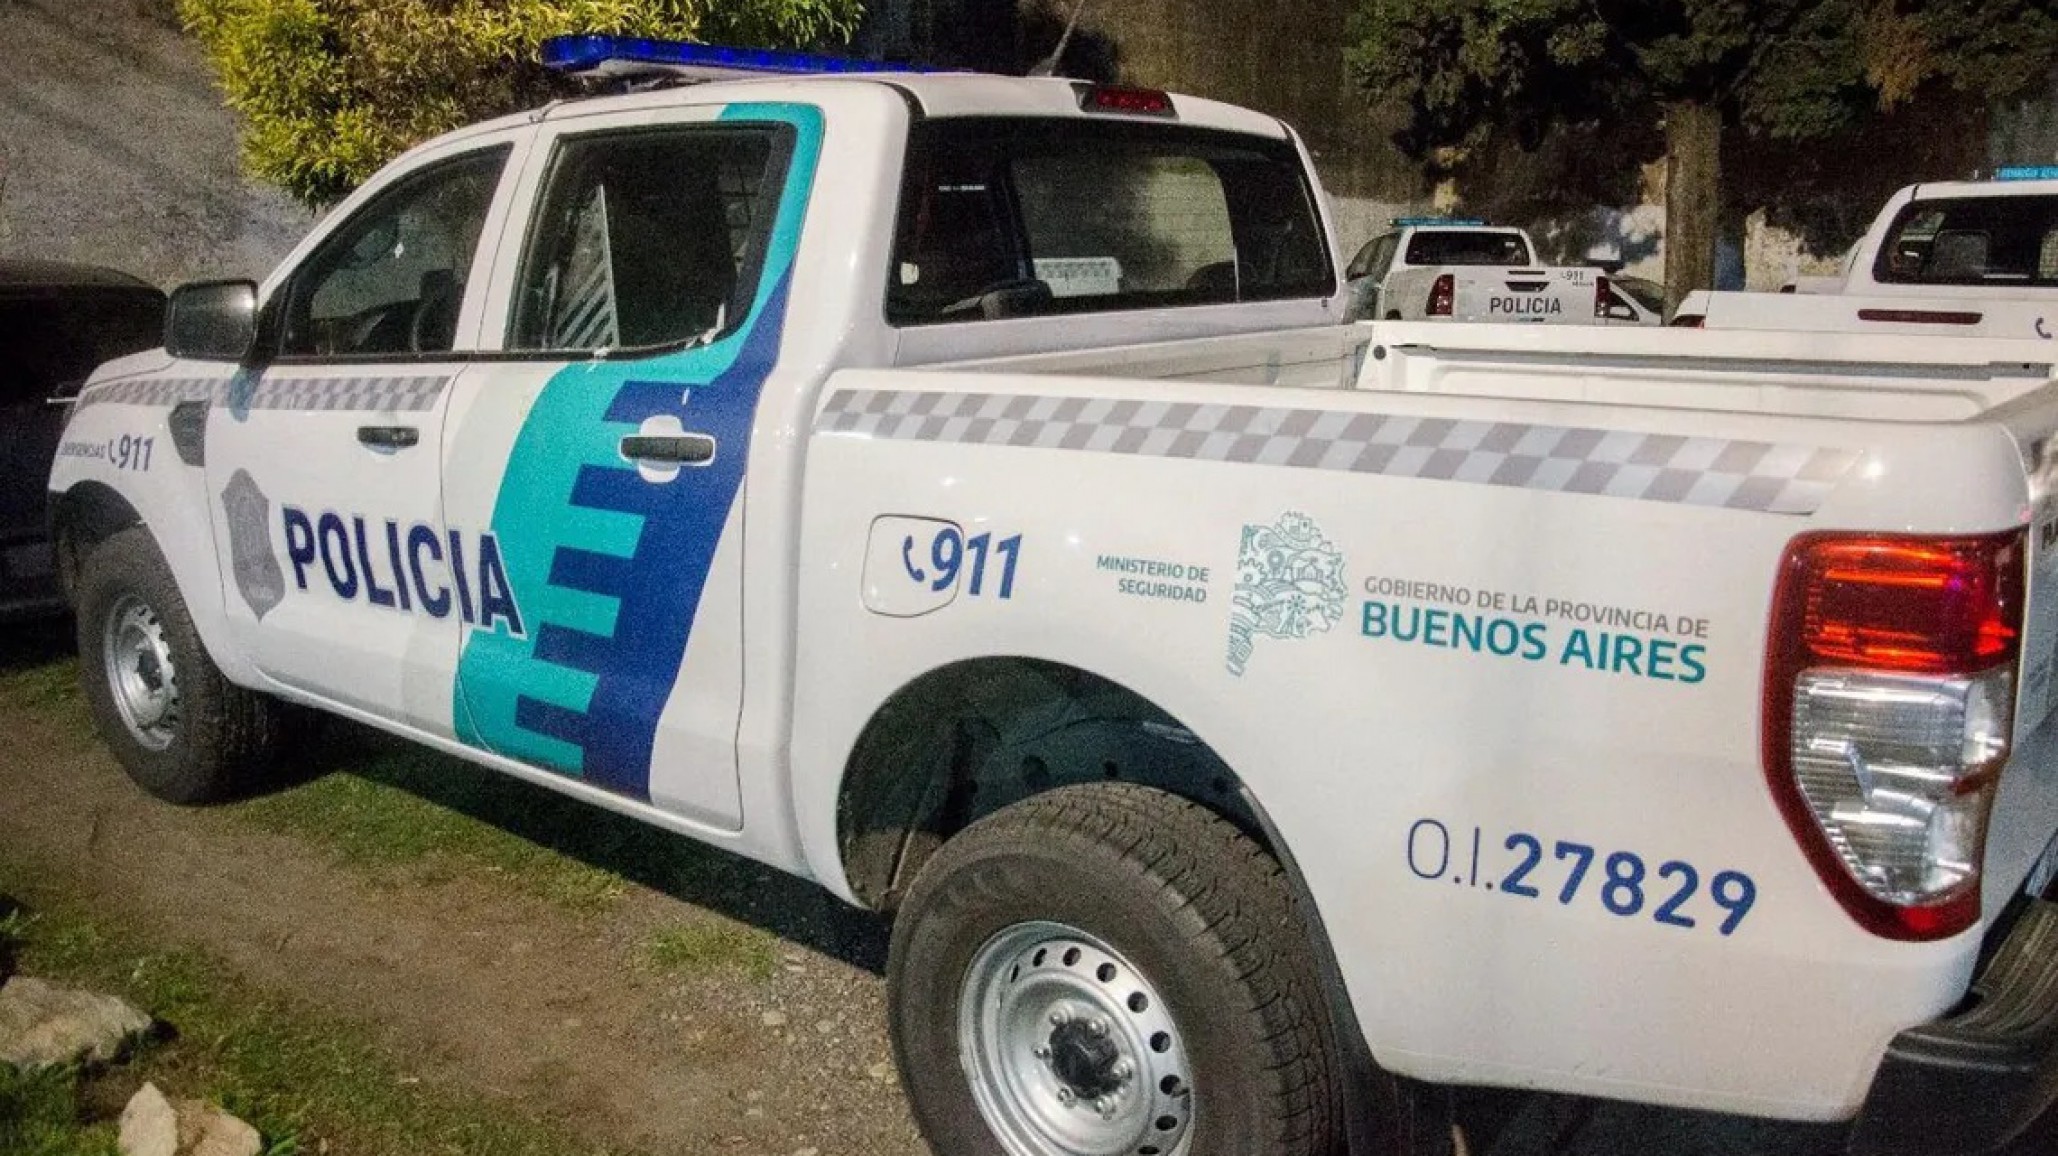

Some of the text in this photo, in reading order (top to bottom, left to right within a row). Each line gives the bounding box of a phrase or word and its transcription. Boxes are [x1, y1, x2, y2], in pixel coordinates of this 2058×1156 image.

[1490, 298, 1561, 314] POLICIA
[119, 434, 154, 471] 911
[283, 507, 523, 635] POLICIA
[931, 528, 1022, 599] 911
[1097, 555, 1209, 582] MINISTERIO DE
[1118, 579, 1207, 602] SEGURIDAD
[1364, 575, 1710, 639] GOBIERNO DE LA PROVINCIA DE
[1361, 601, 1707, 684] BUENOS AIRES
